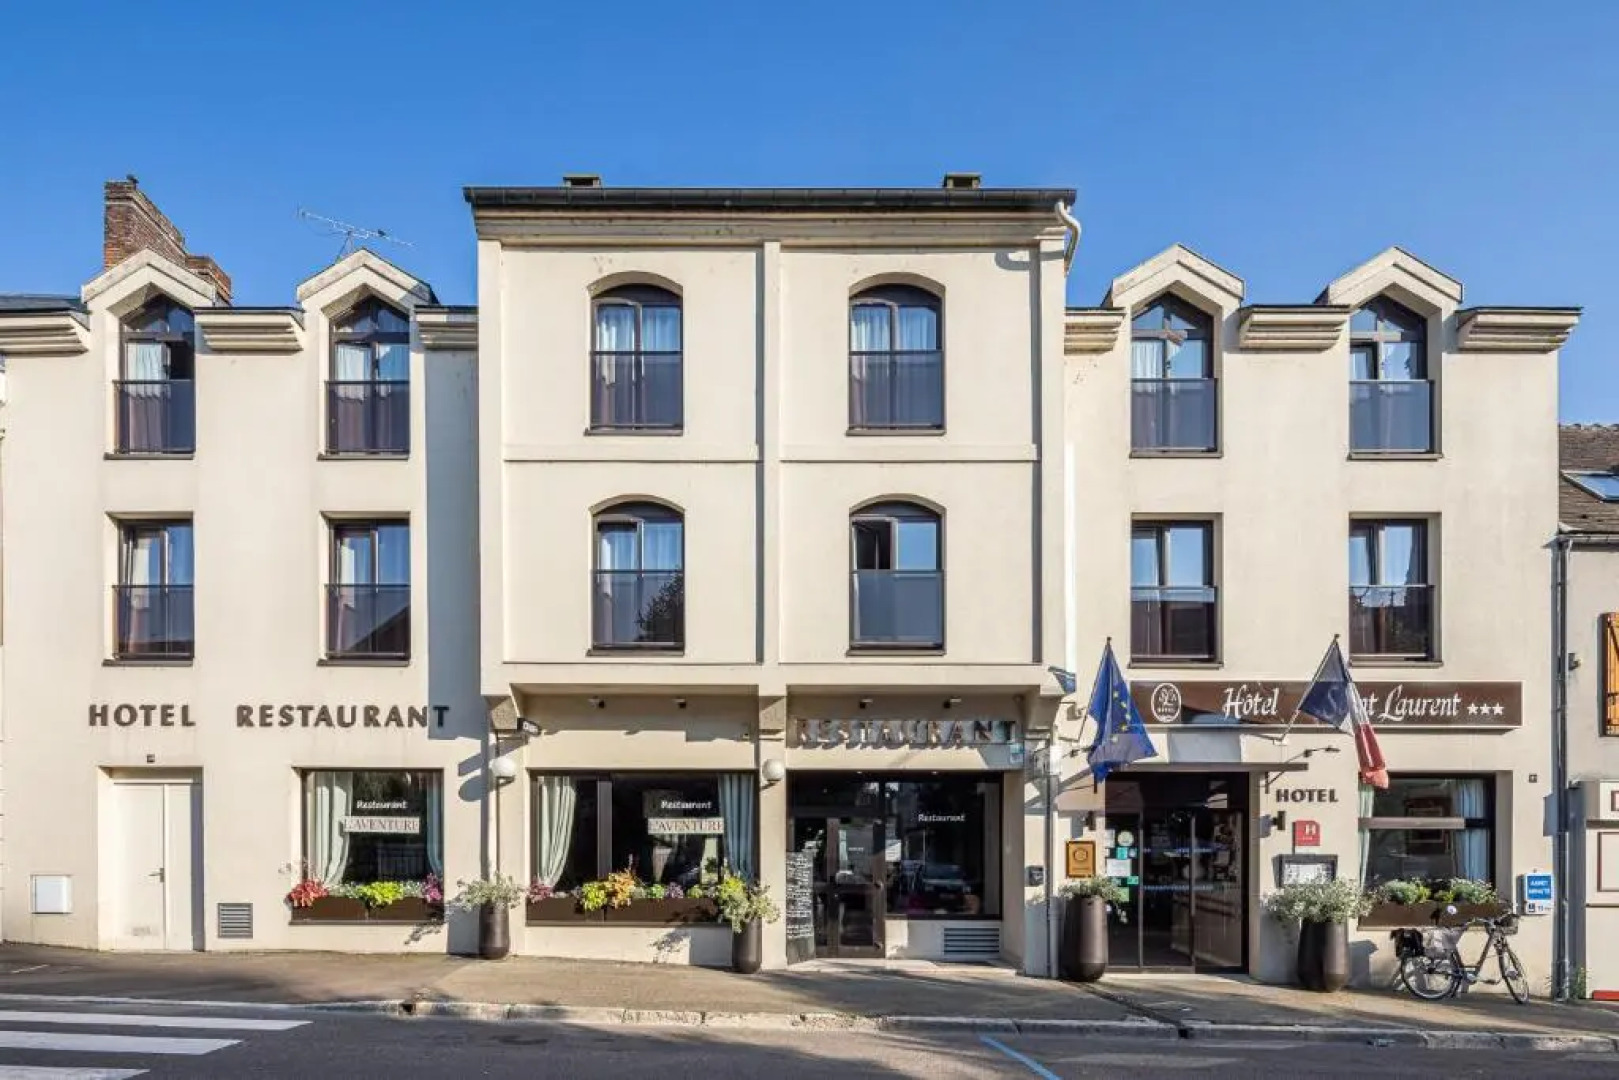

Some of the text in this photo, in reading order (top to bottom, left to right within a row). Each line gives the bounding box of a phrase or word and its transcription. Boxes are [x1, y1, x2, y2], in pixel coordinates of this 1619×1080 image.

[1222, 684, 1280, 721] Hôtel
[1378, 684, 1461, 722] Laurent
[88, 703, 450, 728] HOTEL RESTAURANT
[796, 719, 1017, 744] RESTAURANT
[1275, 788, 1339, 803] HOTEL
[356, 800, 408, 809] Restaurant
[660, 800, 712, 809] Restaurant
[918, 813, 966, 822] Restaurant
[1305, 824, 1317, 836] H
